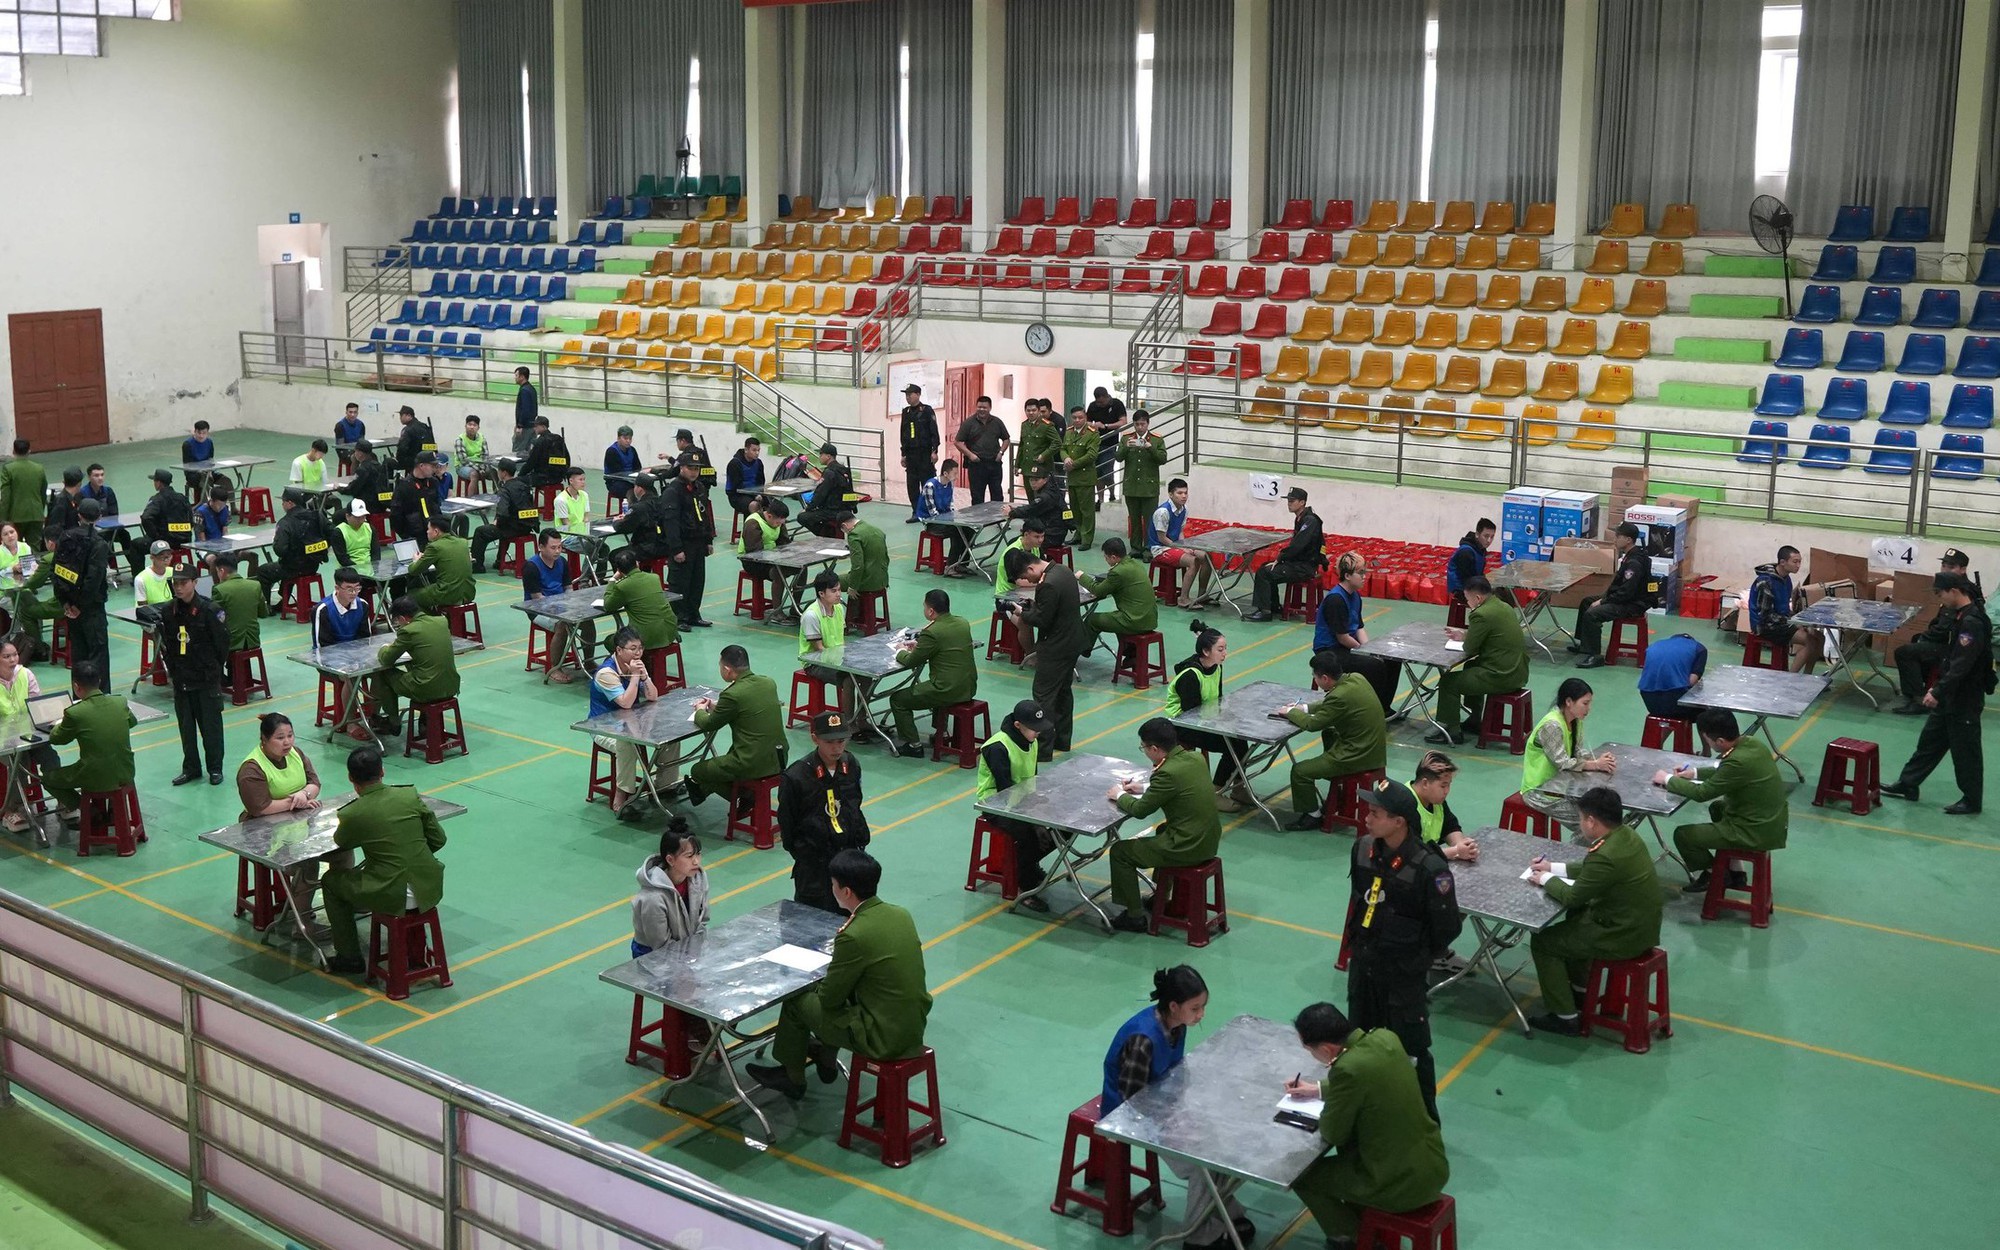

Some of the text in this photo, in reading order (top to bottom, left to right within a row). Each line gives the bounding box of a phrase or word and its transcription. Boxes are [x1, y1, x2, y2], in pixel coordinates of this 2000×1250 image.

[1268, 480, 1279, 497] 3
[1627, 512, 1655, 522] ROSSI
[1900, 546, 1914, 565] 4
